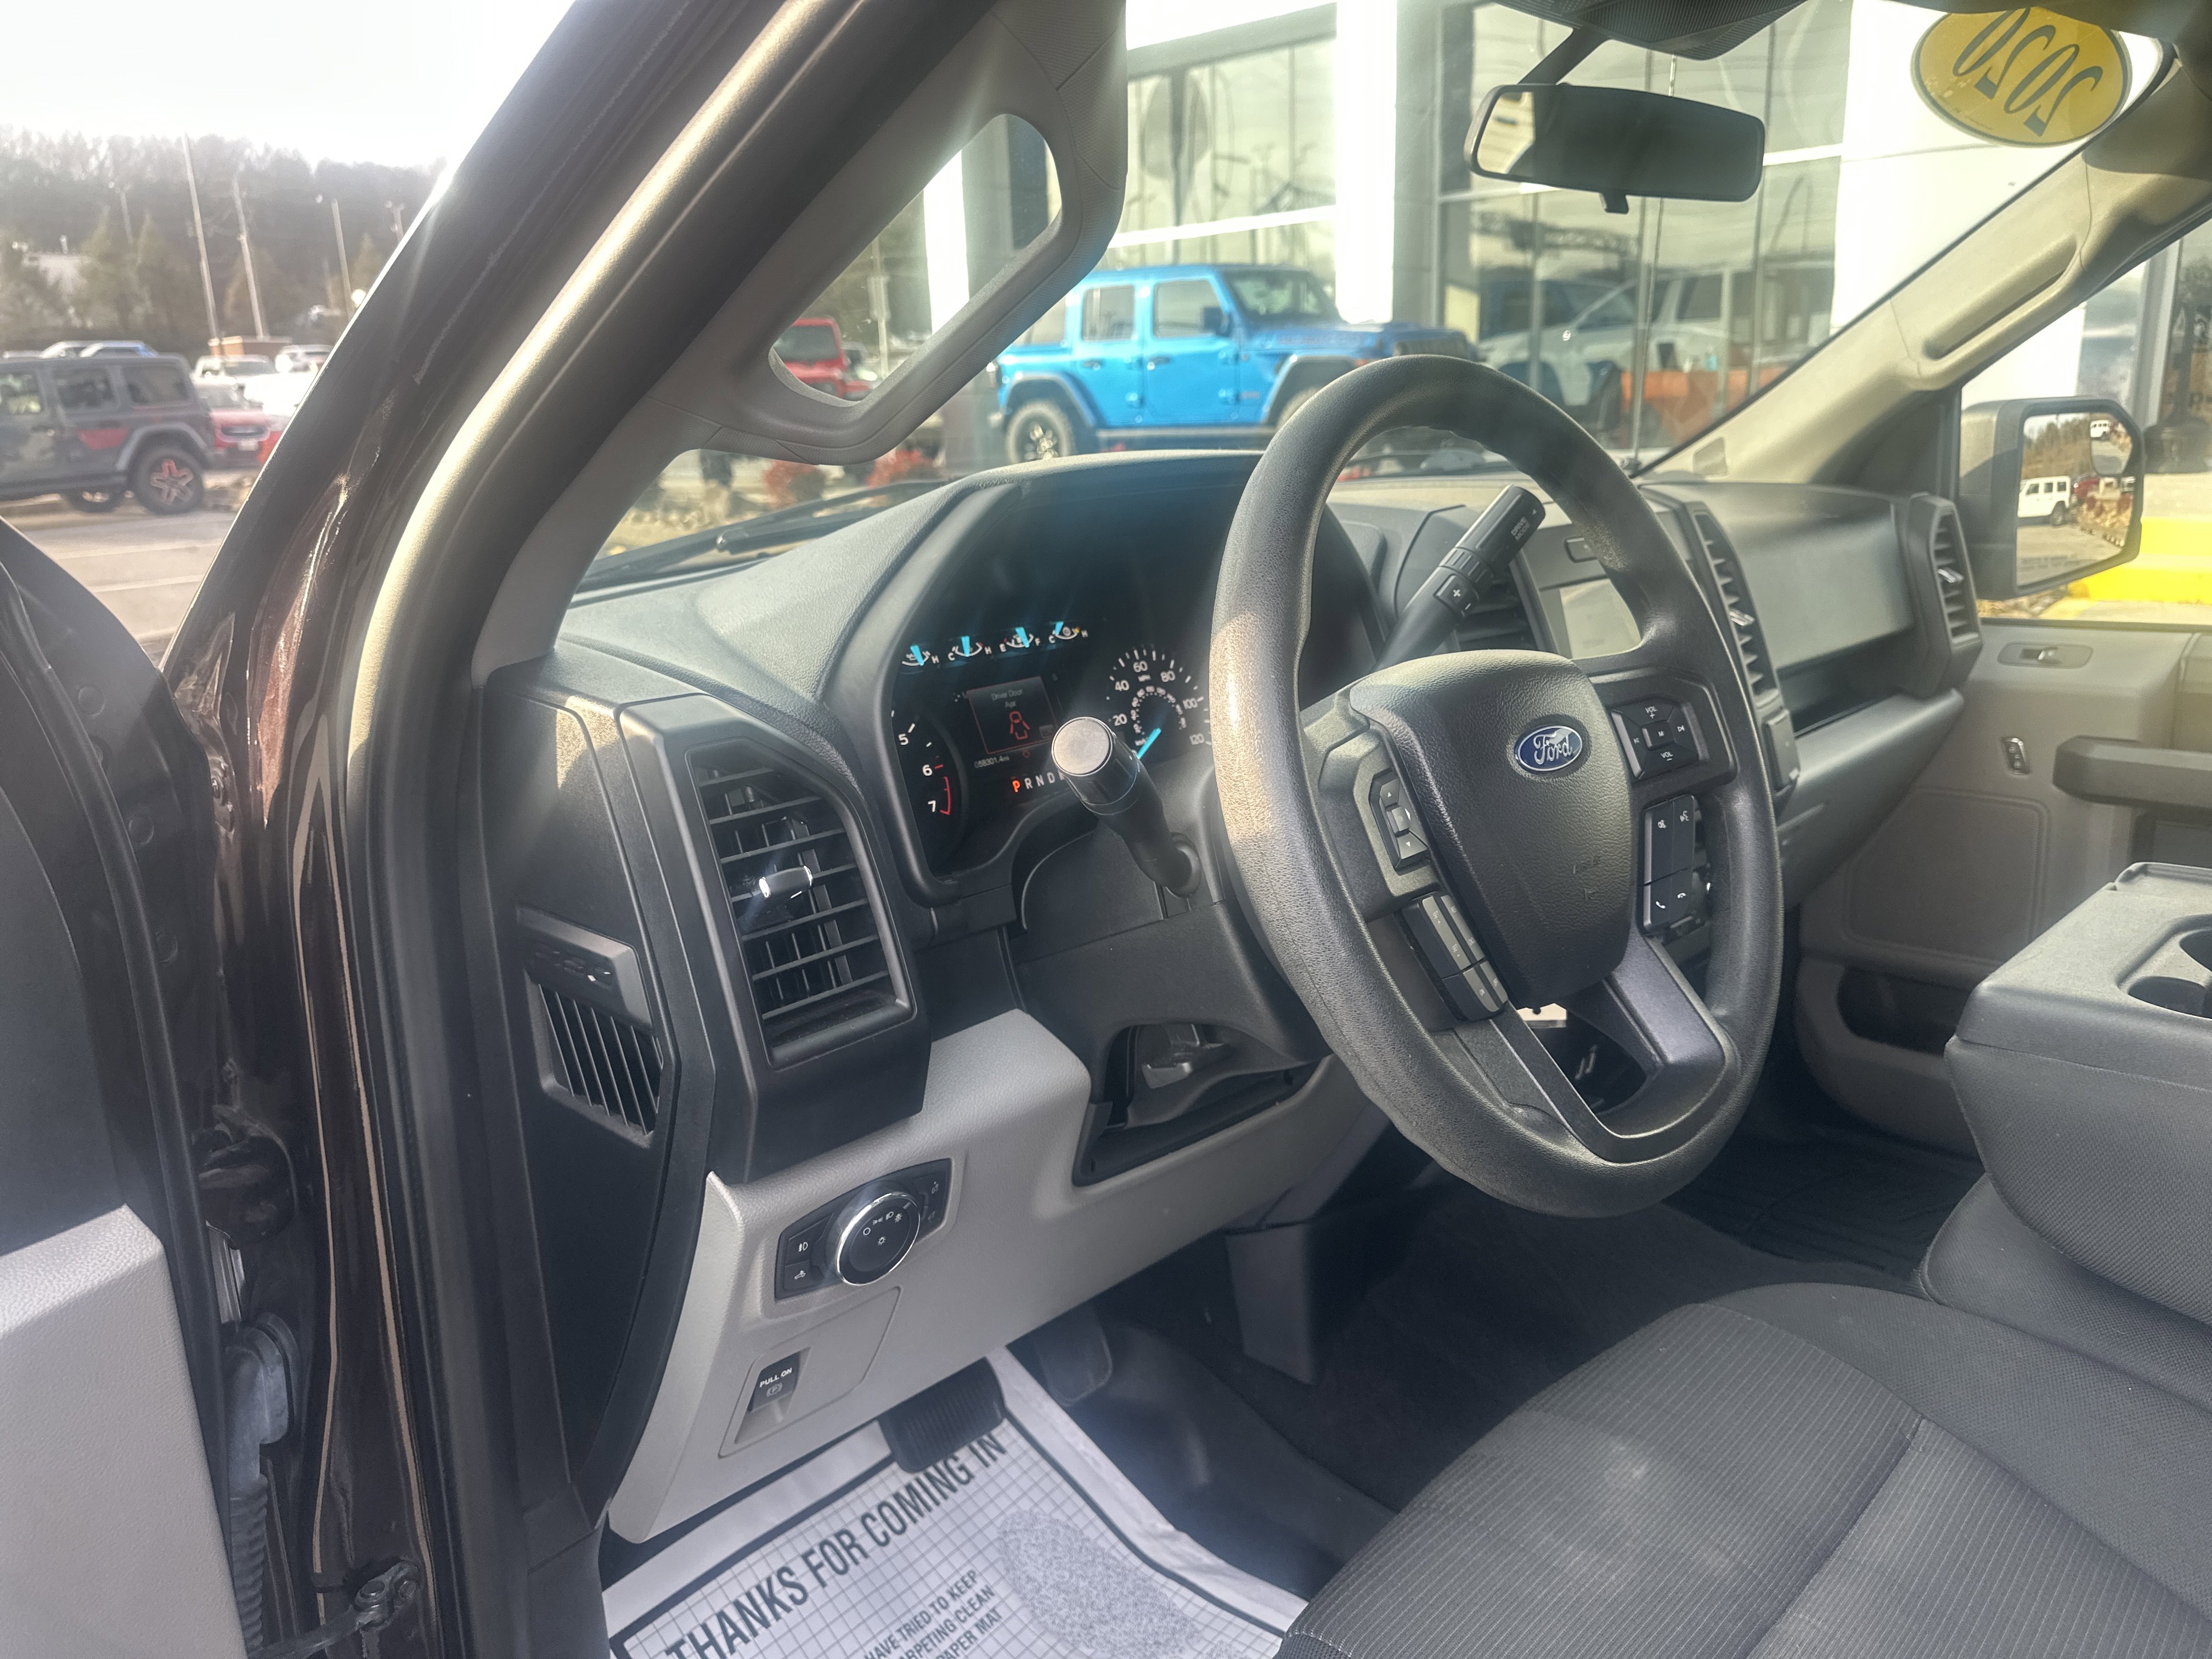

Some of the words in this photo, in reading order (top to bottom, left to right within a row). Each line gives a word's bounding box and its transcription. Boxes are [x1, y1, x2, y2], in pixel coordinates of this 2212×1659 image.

[1510, 517, 1527, 536] DRIVE
[1035, 637, 1041, 646] F
[1049, 635, 1056, 644] C
[984, 646, 992, 655] H
[1000, 643, 1007, 652] E
[932, 656, 940, 664] H
[948, 652, 955, 661] C
[1133, 660, 1148, 673] 60
[1160, 670, 1176, 682] 80
[1115, 680, 1130, 691] 40
[1182, 698, 1198, 709] 100
[1113, 713, 1127, 726] 20
[898, 733, 909, 746] 5
[1189, 733, 1204, 745] 120
[1533, 730, 1572, 765] Ford
[922, 764, 933, 776] 6
[1012, 780, 1021, 793] P
[1024, 777, 1033, 789] R
[1035, 774, 1045, 787] N
[1047, 772, 1056, 783] D
[928, 800, 936, 812] 7
[759, 1375, 780, 1387] PULL
[781, 1367, 793, 1378] ON
[665, 1565, 809, 1659] THANKS
[801, 1528, 870, 1588] FOR
[861, 1454, 975, 1547] COMING
[968, 1432, 1007, 1468] IN
[895, 1610, 932, 1641] TRIED
[929, 1596, 950, 1615] TO
[946, 1570, 977, 1601] KEEP
[900, 1618, 957, 1659] RPETING
[954, 1585, 996, 1623] CLEAN
[974, 1606, 1002, 1634] MAT
